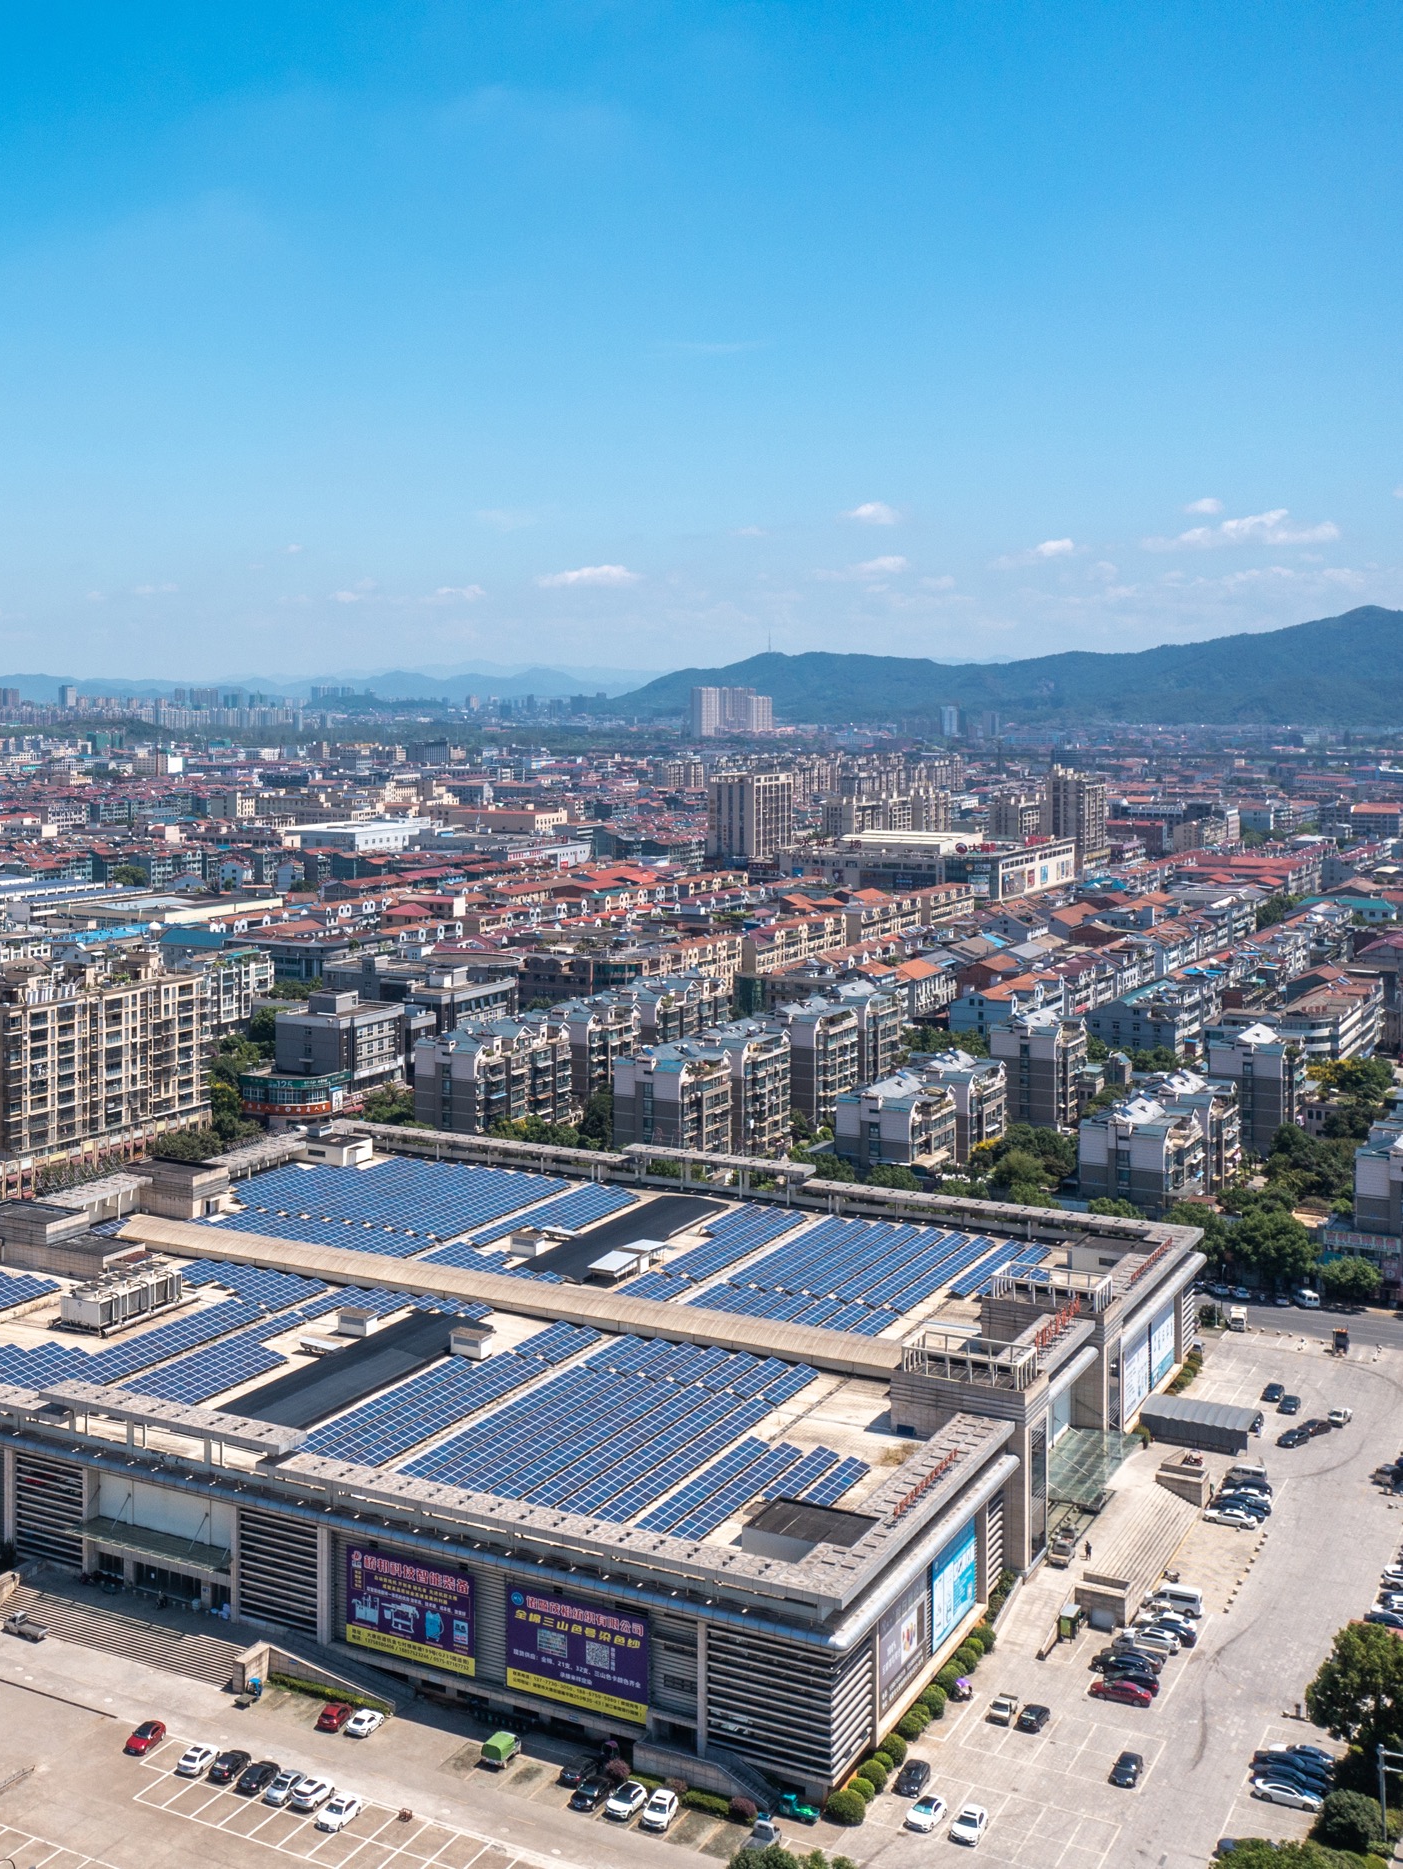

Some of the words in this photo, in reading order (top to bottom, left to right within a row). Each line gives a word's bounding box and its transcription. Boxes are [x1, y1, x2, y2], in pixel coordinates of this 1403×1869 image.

[363, 1553, 469, 1596] 桥邦科技智能装备
[513, 1607, 641, 1651] 全棉三山色号染色纱
